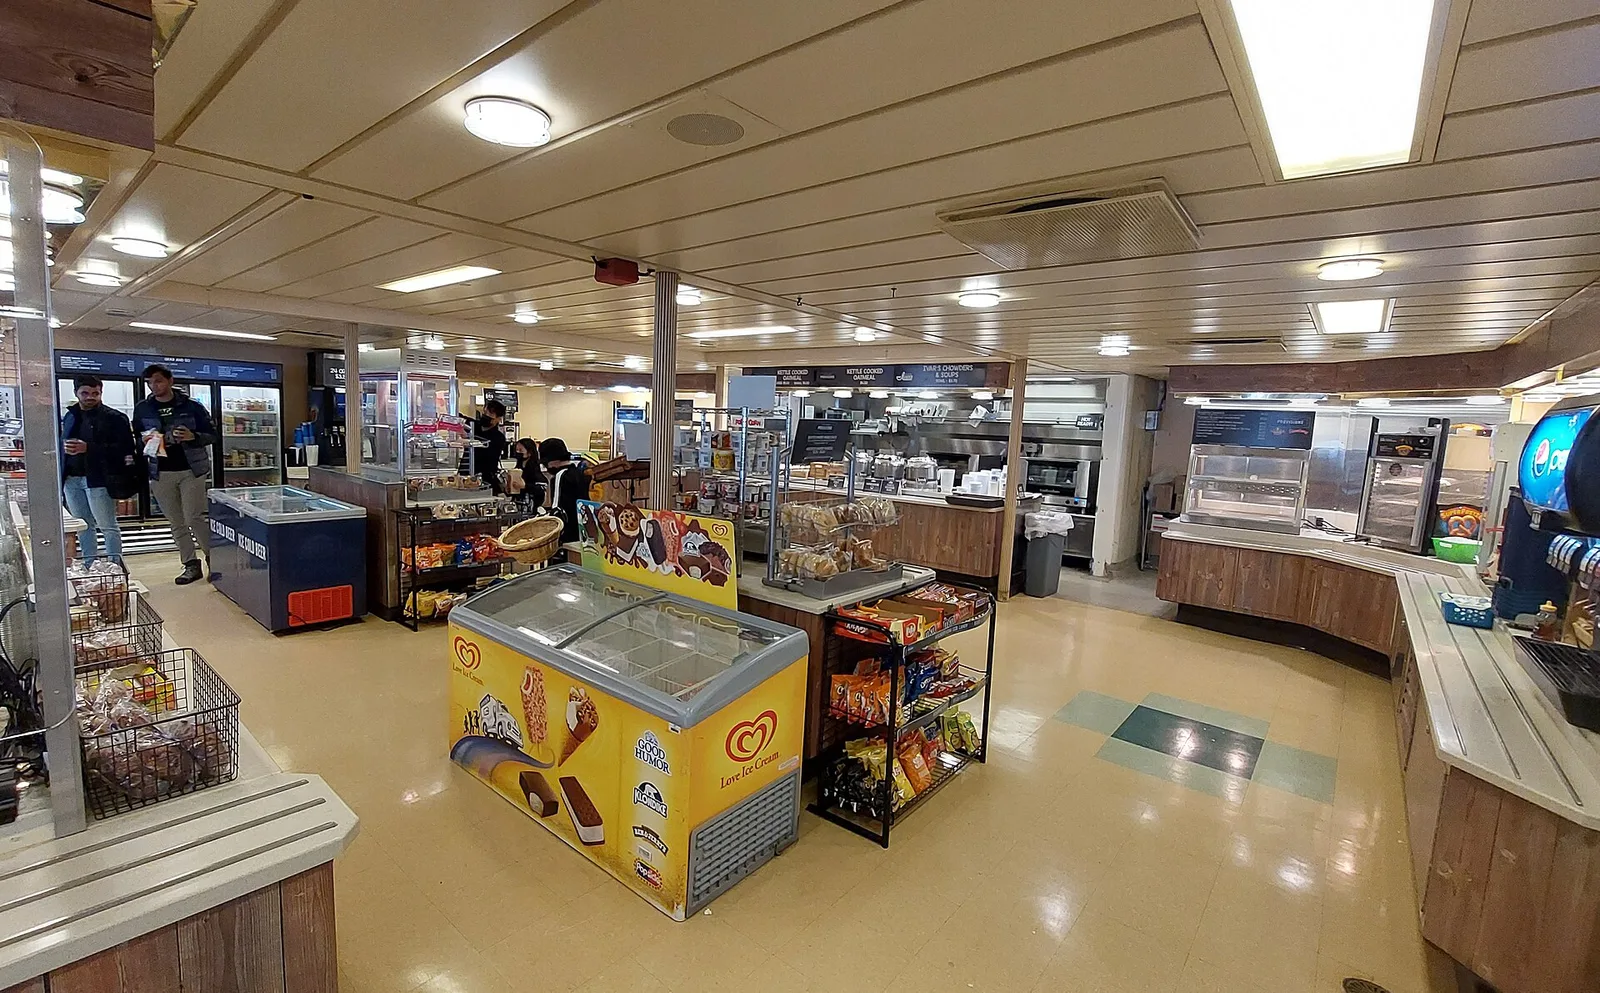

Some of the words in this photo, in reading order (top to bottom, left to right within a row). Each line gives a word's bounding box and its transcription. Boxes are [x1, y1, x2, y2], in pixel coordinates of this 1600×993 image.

[863, 367, 884, 375] COOKED
[216, 521, 225, 537] COLD
[225, 525, 236, 542] BEER
[245, 536, 255, 555] COLD
[255, 542, 267, 561] BEER
[635, 747, 671, 775] HUMOR
[638, 738, 666, 760] GOOD
[720, 772, 741, 790] Love
[742, 765, 754, 778] Ice
[754, 751, 779, 770] Cream
[634, 788, 668, 818] KLONDIKE
